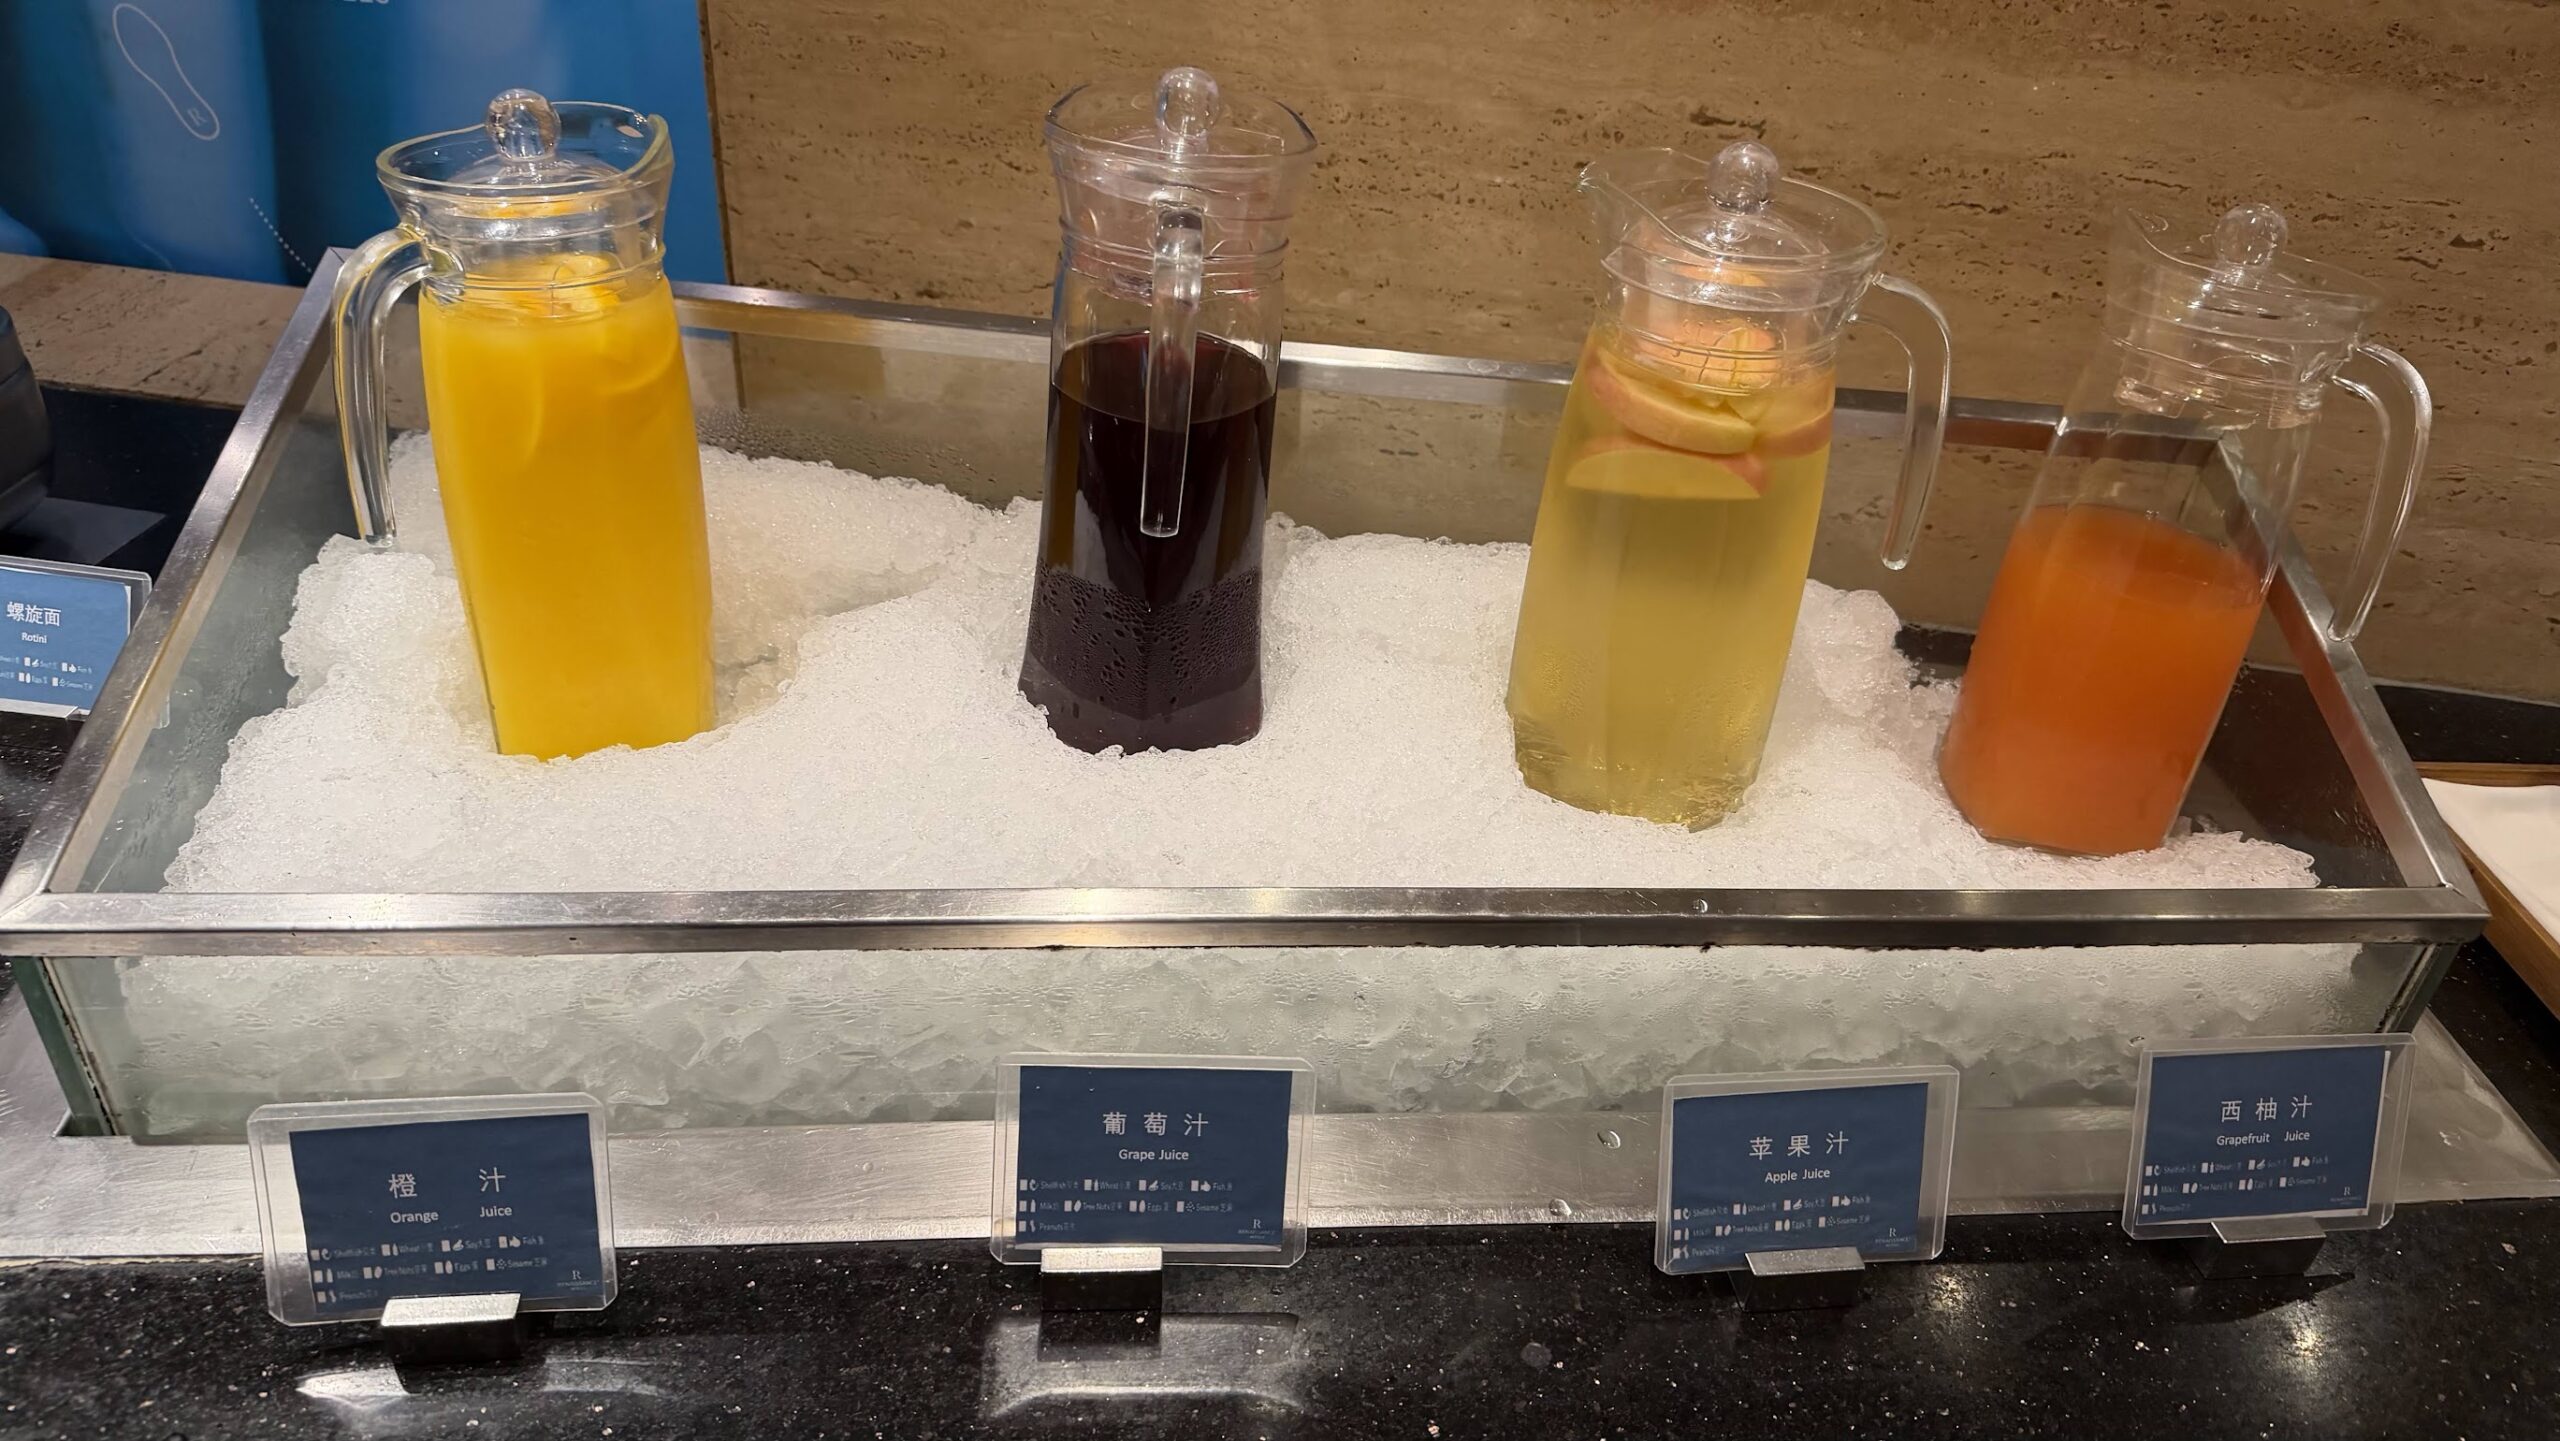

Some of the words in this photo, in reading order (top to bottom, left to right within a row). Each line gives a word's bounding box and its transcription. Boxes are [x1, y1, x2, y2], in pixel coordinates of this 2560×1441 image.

[6, 601, 62, 627] 螺旋面
[21, 632, 47, 644] Rotini
[2220, 1094, 2312, 1123] 西柚汁
[1103, 1112, 1208, 1136] 葡萄汁
[1749, 1131, 1849, 1161] 苹果汁
[2216, 1132, 2270, 1147] Grapefruit
[2284, 1130, 2310, 1142] Juice
[1119, 1149, 1155, 1162] Grape
[1159, 1149, 1189, 1160] Juice
[1765, 1169, 1798, 1184] Apple
[1802, 1167, 1831, 1180] Juice
[390, 1210, 439, 1224] Orange
[479, 1205, 513, 1218] Juice
